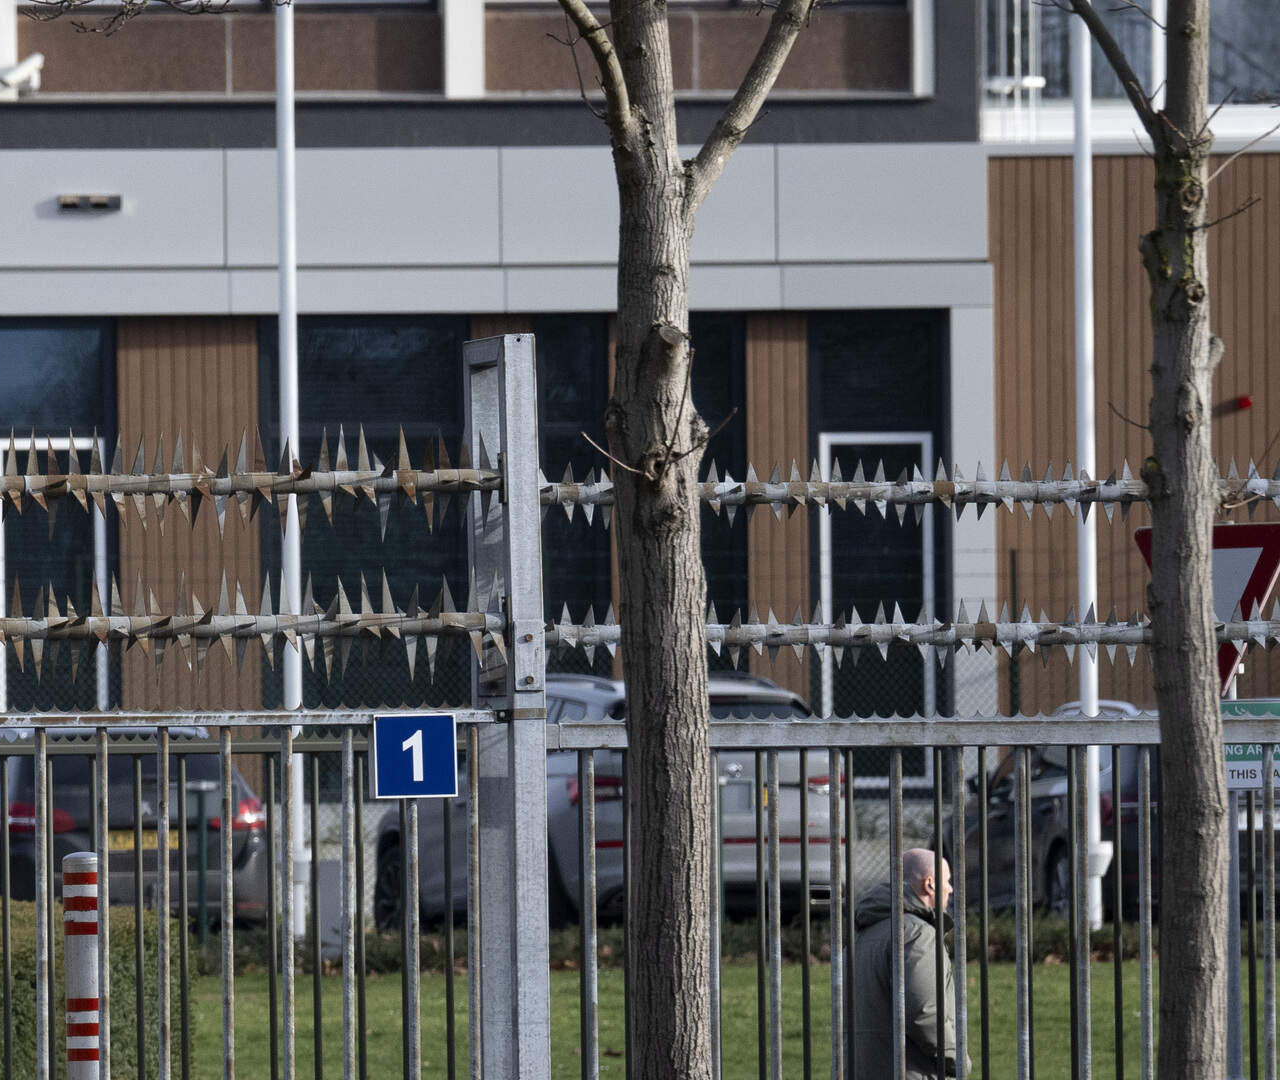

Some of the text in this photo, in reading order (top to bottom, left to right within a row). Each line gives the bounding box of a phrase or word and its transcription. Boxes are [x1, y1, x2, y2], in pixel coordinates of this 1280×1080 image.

[1247, 744, 1280, 755] ARA
[401, 730, 424, 782] 1
[1229, 769, 1257, 779] THIS
